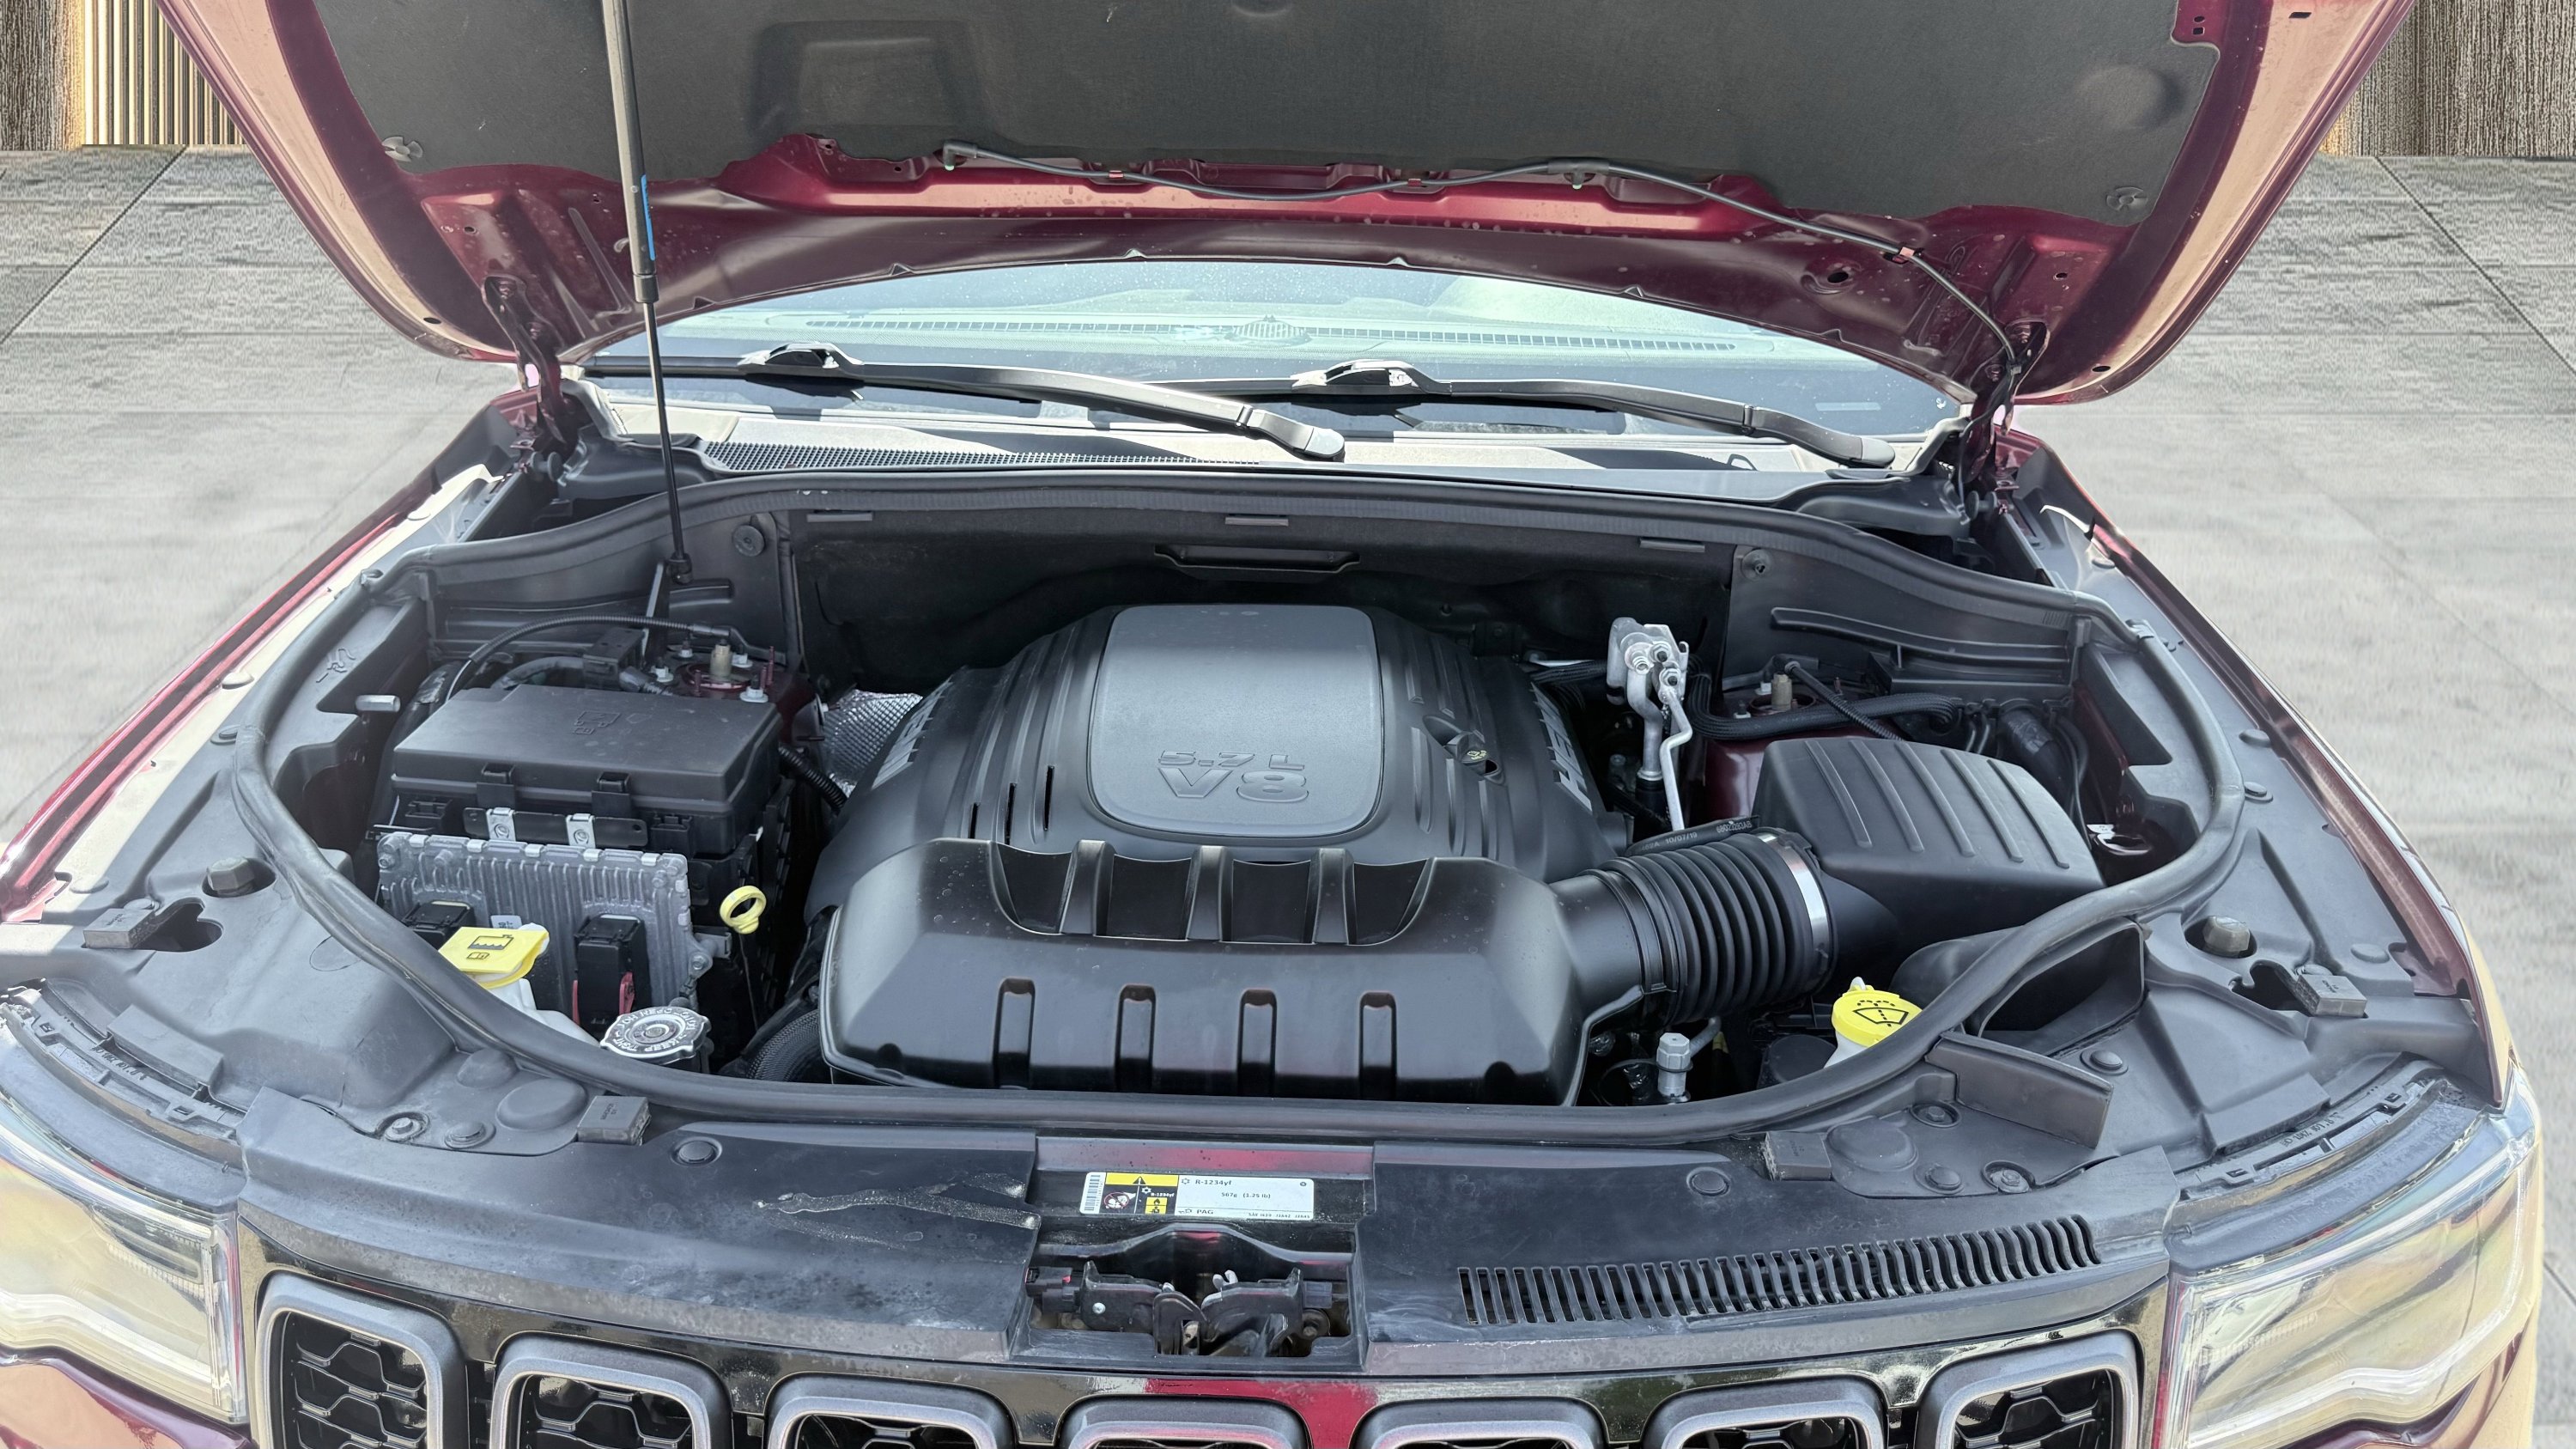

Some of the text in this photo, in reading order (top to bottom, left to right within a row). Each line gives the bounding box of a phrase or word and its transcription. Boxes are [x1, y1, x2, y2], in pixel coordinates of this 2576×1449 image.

[1158, 768, 1309, 803] V8
[1665, 831, 1698, 845] 10/07/19
[612, 1038, 680, 1052] KEEP TIGHT
